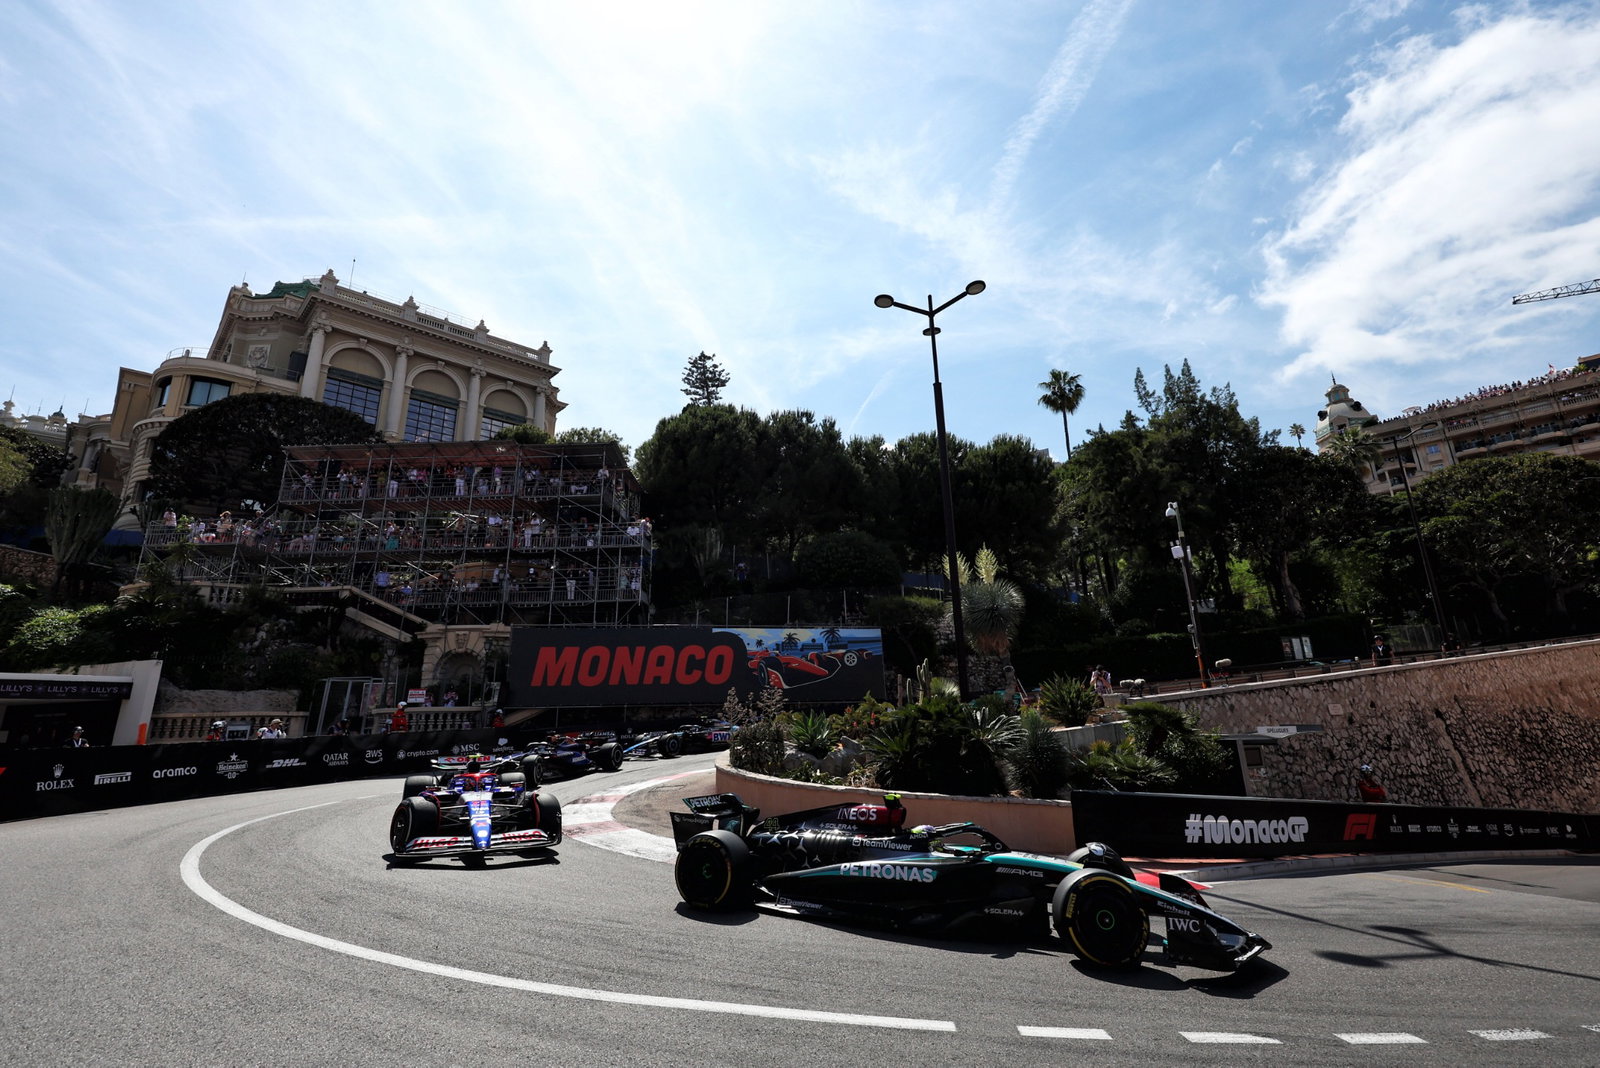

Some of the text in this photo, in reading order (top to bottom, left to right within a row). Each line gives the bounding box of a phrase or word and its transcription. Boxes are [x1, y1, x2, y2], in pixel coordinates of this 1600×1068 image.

[530, 644, 735, 687] MONACO
[0, 684, 33, 692] LILLY'S
[47, 685, 78, 693] LILLY'S
[365, 749, 383, 758] aws
[406, 749, 440, 758] crypto.com
[460, 743, 481, 753] MSC
[271, 758, 300, 768] DHL
[323, 752, 349, 763] QATAR
[152, 766, 198, 779] aramco
[218, 763, 246, 771] Heineken
[36, 778, 75, 791] ROLEX
[94, 771, 132, 785] PIRELLI
[837, 807, 877, 821] INEOS
[763, 817, 780, 832] 44
[824, 823, 851, 831] SOLERA
[1185, 813, 1309, 844] #MonacoGP
[1343, 813, 1377, 840] F1
[862, 838, 912, 851] TeamViewer
[840, 863, 937, 884] PETRONAS
[1011, 868, 1044, 878] AMG
[988, 907, 1018, 916] SOLERA
[1156, 900, 1190, 916] Einhell
[1168, 917, 1201, 933] IWC
